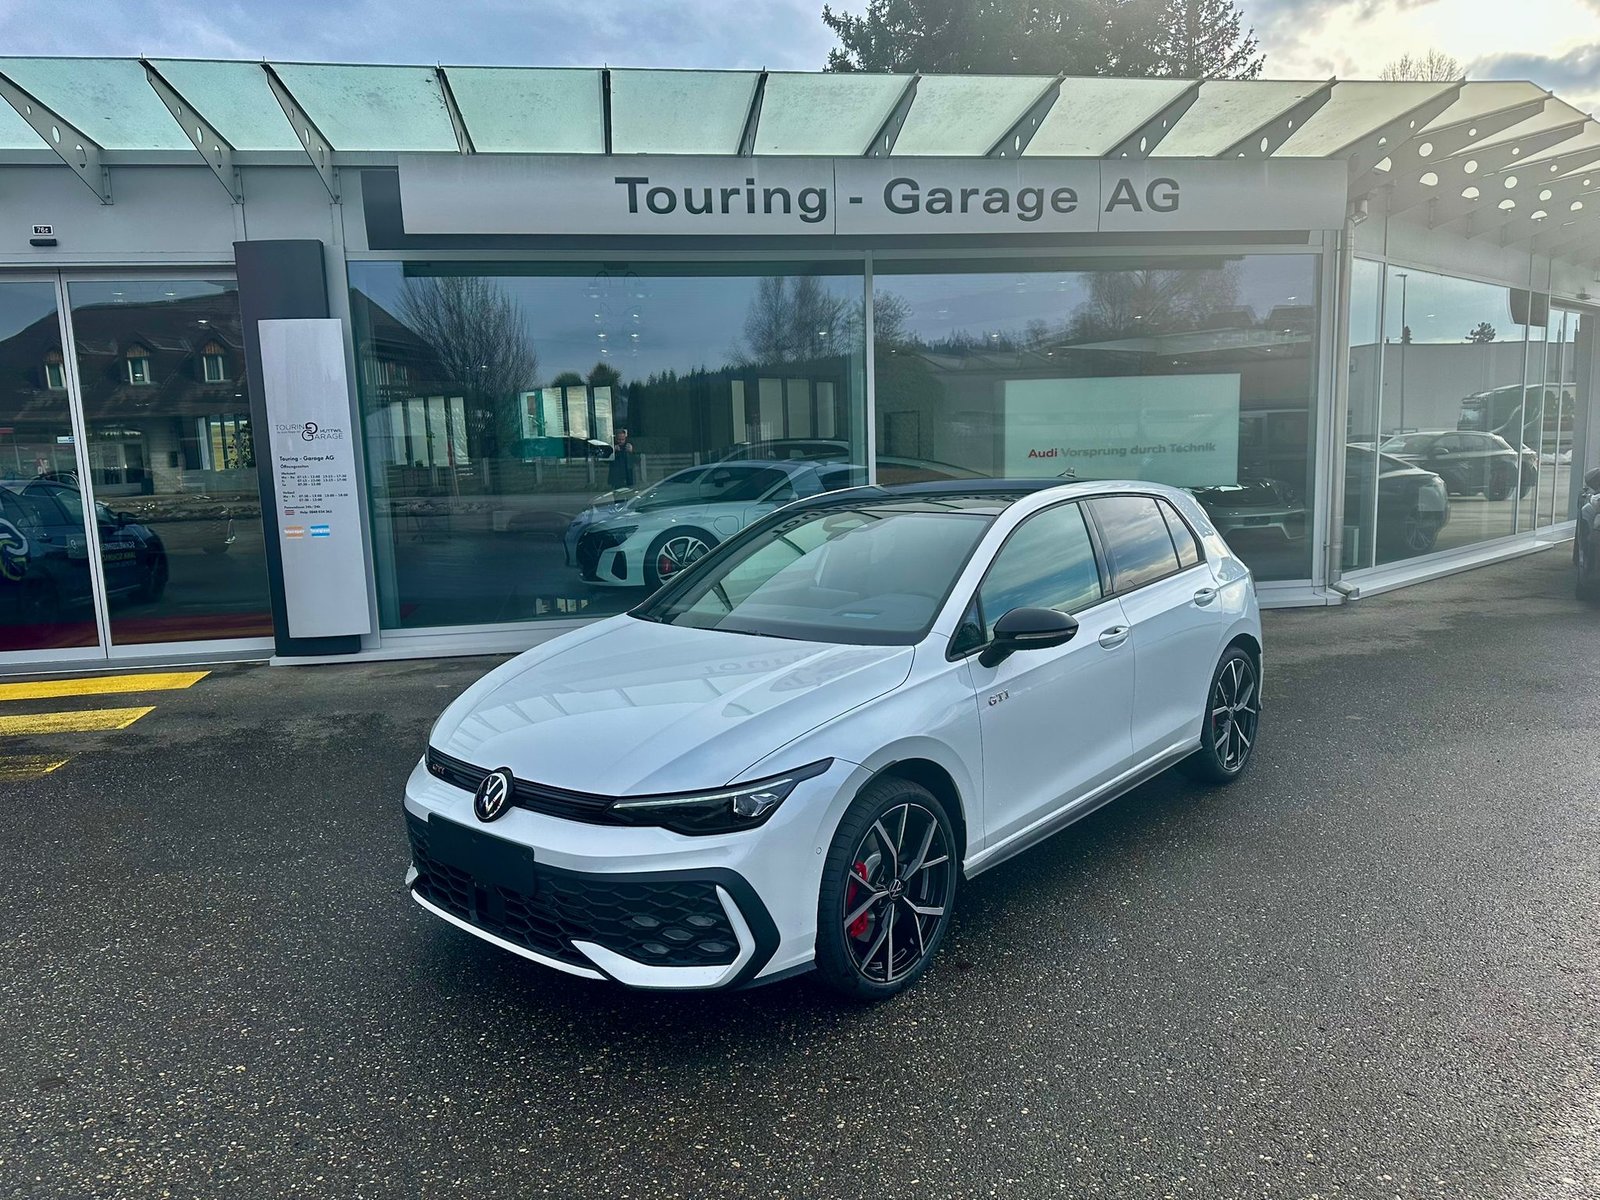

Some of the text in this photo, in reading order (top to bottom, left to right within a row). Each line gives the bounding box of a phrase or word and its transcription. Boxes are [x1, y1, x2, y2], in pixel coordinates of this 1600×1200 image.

[614, 176, 1181, 224] Touring - Garage AG
[1028, 442, 1216, 459] Audi Vorsprung durch Technik
[988, 688, 1009, 706] GTI
[432, 763, 446, 775] GTI
